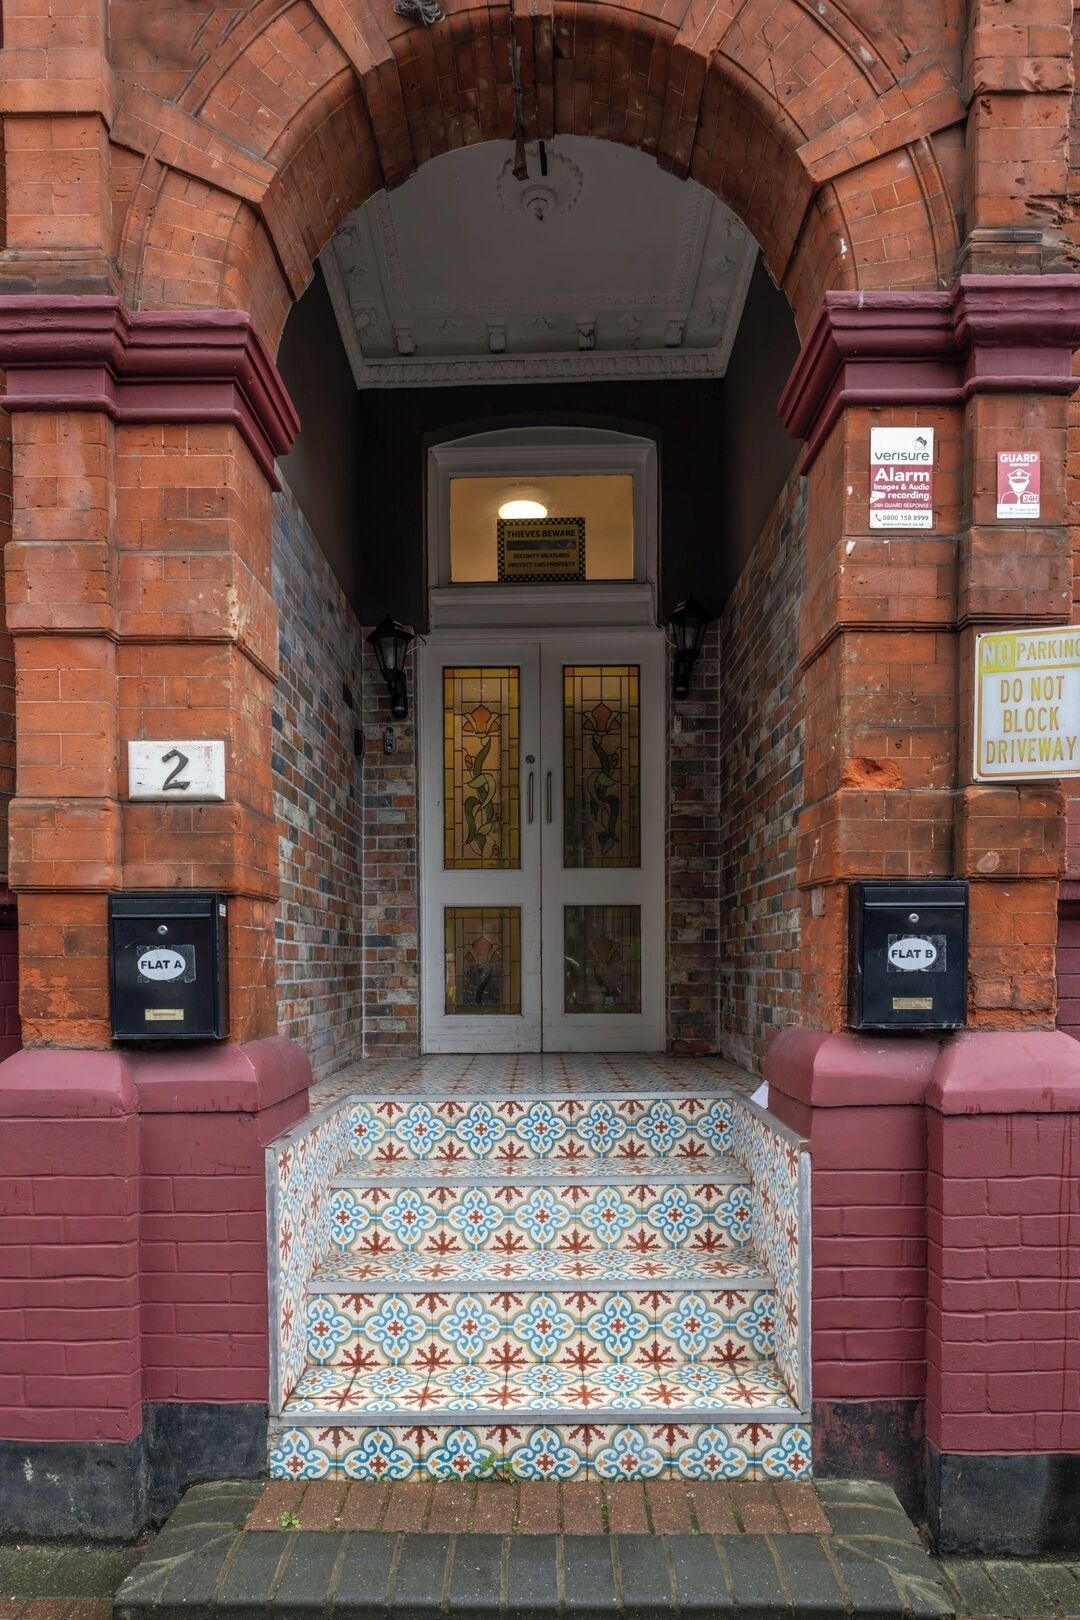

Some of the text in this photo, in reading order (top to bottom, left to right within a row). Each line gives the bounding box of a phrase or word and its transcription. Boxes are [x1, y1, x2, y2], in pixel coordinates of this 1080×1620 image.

[875, 452, 930, 461] verisure
[1000, 453, 1038, 463] GUARD
[874, 467, 930, 482] Alarm
[873, 483, 899, 491] Images
[887, 491, 930, 501] recording
[507, 530, 540, 538] THIEVES
[983, 640, 1011, 668] NO
[1000, 675, 1065, 703] DO NOT
[1003, 707, 1059, 733] BLOCK
[986, 735, 1077, 765] DRIVEWAY
[161, 748, 191, 791] 2
[891, 949, 933, 959] FLAT B
[140, 960, 183, 970] FLAT A
